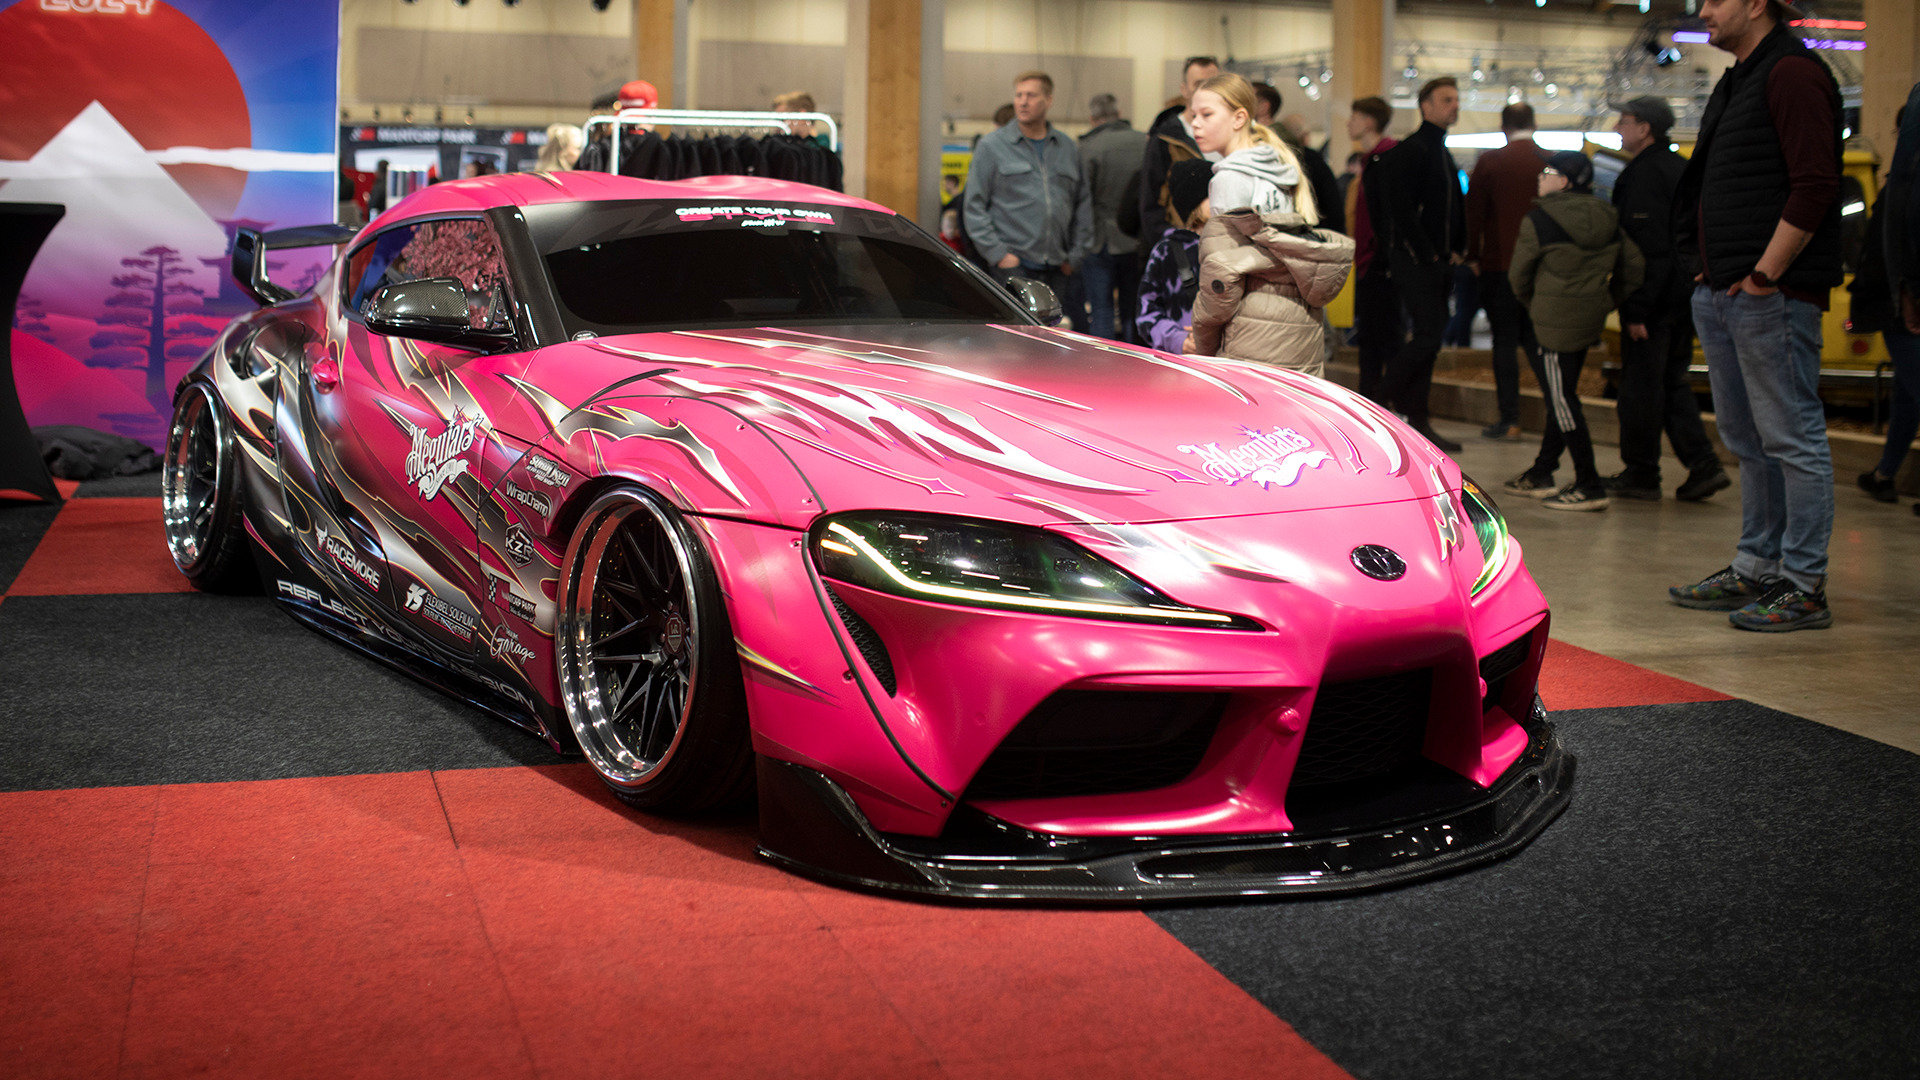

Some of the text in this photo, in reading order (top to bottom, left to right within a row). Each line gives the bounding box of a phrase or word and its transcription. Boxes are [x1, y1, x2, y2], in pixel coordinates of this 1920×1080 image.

[377, 128, 477, 144] MANTORP PARK
[675, 207, 832, 219] CREATE YOUR OWN
[326, 537, 380, 590] RACEMORE
[505, 537, 533, 557] KZR
[276, 579, 368, 626] REFLECT
[425, 593, 473, 628] FLEXIBEL SOLFILM
[490, 624, 536, 665] Garage
